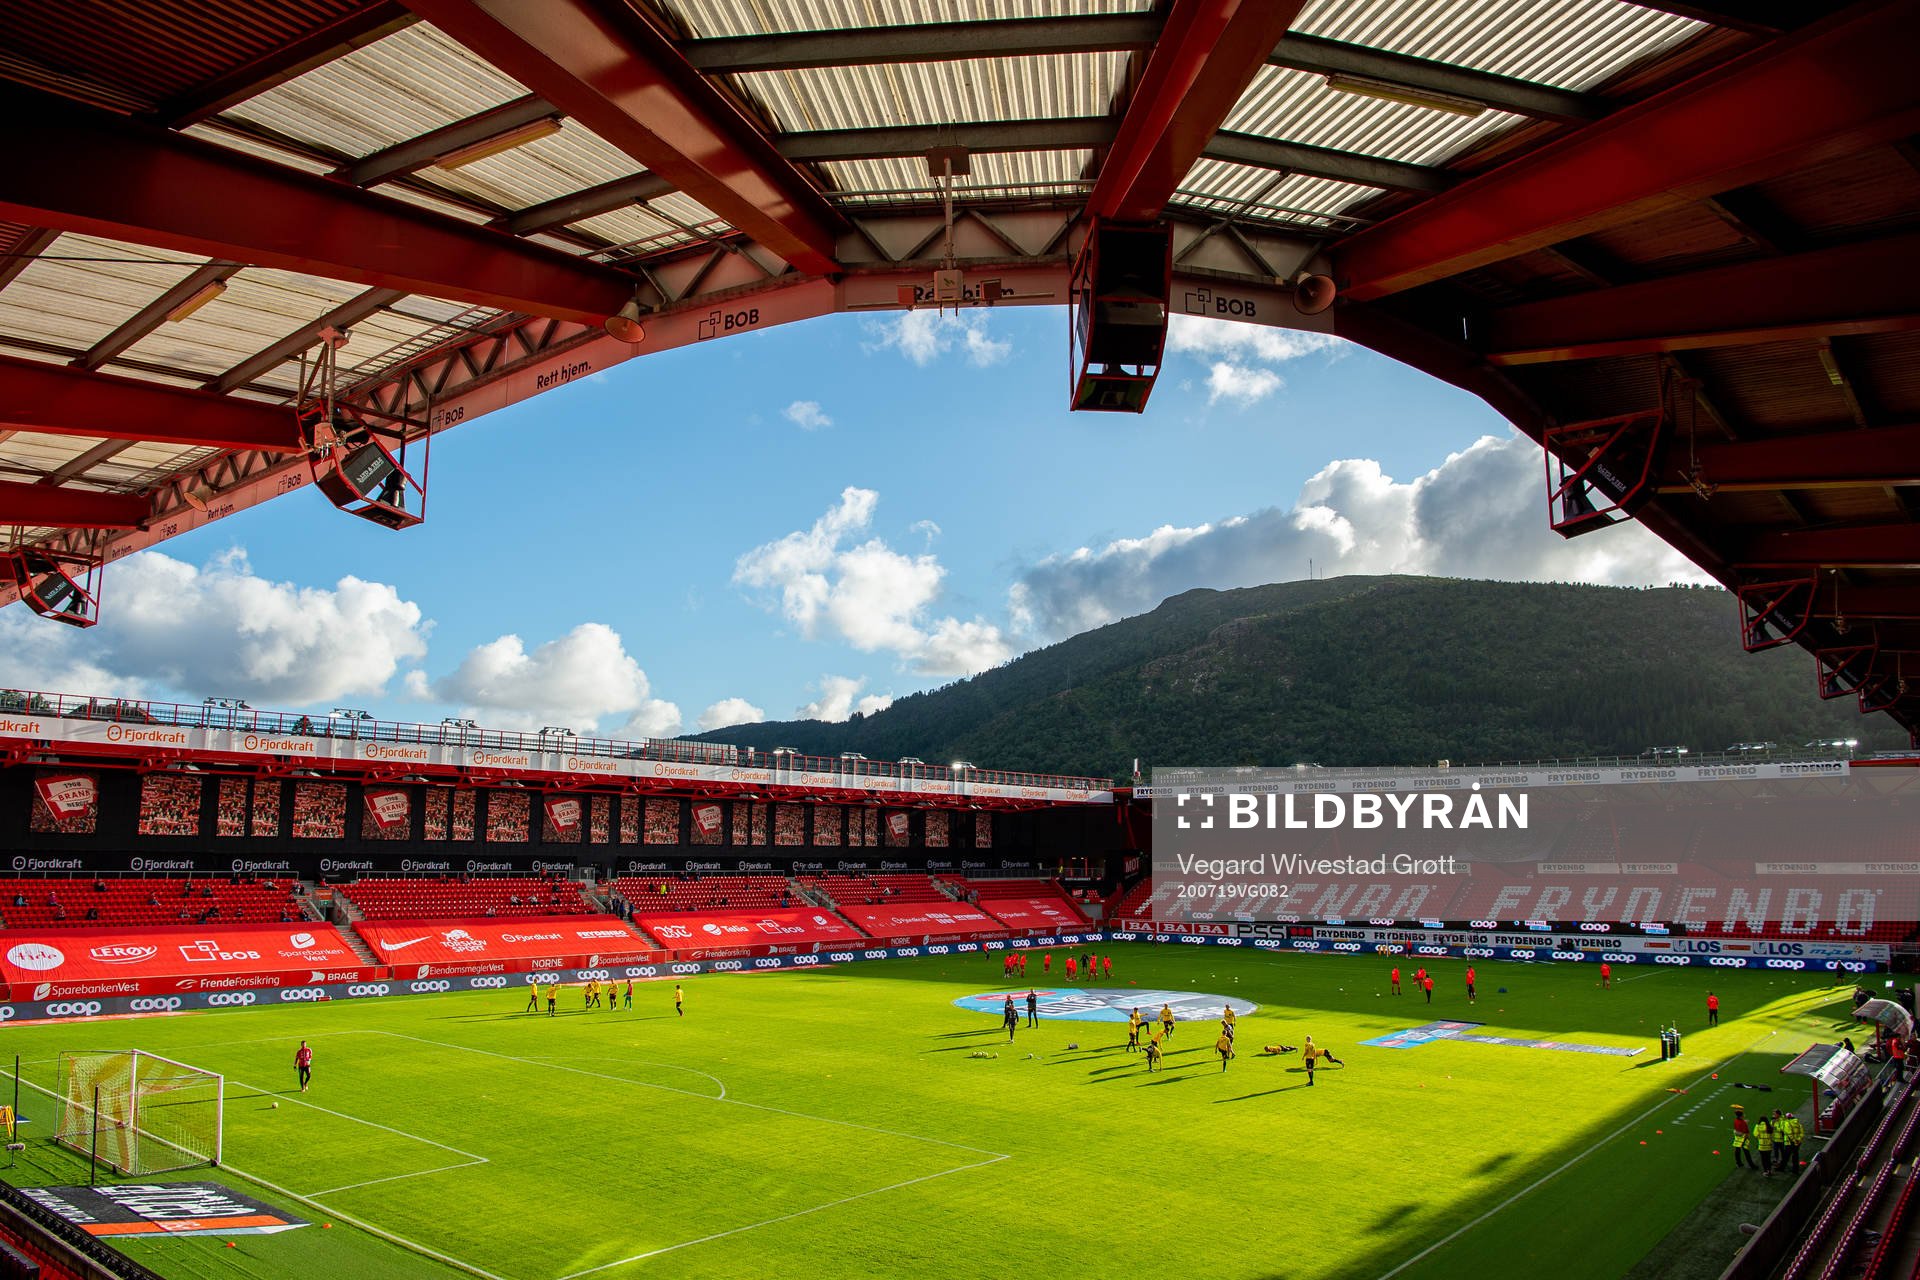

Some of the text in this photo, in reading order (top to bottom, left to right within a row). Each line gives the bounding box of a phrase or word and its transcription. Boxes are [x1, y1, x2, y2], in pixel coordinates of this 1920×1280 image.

[1216, 297, 1256, 317] BOB
[724, 309, 759, 330] BOB
[537, 360, 592, 389] Rett hjem.
[445, 407, 464, 425] BOB
[287, 474, 301, 488] BOB
[166, 523, 177, 535] BOB
[125, 729, 186, 743] Fjordkraft
[260, 739, 314, 751] Fjordkraft
[379, 747, 427, 758] Fjordkraft
[485, 754, 528, 766] Fjordkraft
[578, 760, 617, 771] Fjordkraft
[664, 766, 699, 776] Fjordkraft
[740, 772, 771, 781] Fjordkraft
[808, 776, 838, 785] Fjordkraft
[28, 858, 82, 870] Fjordkraft
[144, 858, 194, 870] Fjordkraft
[245, 860, 290, 871] Fjordkraft
[331, 860, 373, 871] Fjordkraft
[411, 861, 450, 871] Fjordkraft
[476, 861, 512, 871] Fjordkraft
[542, 862, 574, 871] Fjordkraft
[637, 862, 666, 871] Fjordkraft
[693, 862, 721, 871] Fjordkraft
[1192, 912, 1213, 920] coop
[1277, 913, 1300, 923] coop
[1369, 917, 1394, 926] coop
[1470, 920, 1497, 929] coop
[1580, 923, 1610, 933] coop
[515, 933, 563, 942] Fjordkraft
[1038, 937, 1055, 946] coop
[1062, 935, 1080, 944] coop
[1086, 933, 1103, 942] coop
[1181, 935, 1205, 944] coop
[1217, 937, 1241, 946] coop
[986, 941, 1005, 950] coop
[1012, 939, 1030, 948] coop
[1254, 939, 1280, 948] coop
[1293, 940, 1319, 950] coop
[1333, 943, 1361, 952] coop
[1687, 941, 1721, 953] LOS
[90, 945, 153, 958] LERØY
[278, 949, 344, 958] Sparebanken
[897, 947, 919, 956] coop
[929, 945, 949, 954] coop
[1464, 948, 1494, 958] coop
[1768, 942, 1804, 956] LOS
[219, 951, 261, 960] BOB
[830, 953, 854, 962] coop
[865, 950, 887, 959] coop
[1552, 951, 1585, 961] coop
[1602, 953, 1636, 963] coop
[1655, 954, 1691, 965] coop
[532, 959, 563, 968] NORNE
[756, 958, 781, 968] coop
[794, 955, 819, 965] coop
[1709, 956, 1747, 968] coop
[1765, 958, 1805, 970] coop
[672, 963, 701, 974] coop
[715, 960, 742, 971] coop
[327, 972, 358, 980] BRAGE
[577, 970, 609, 981] coop
[626, 967, 657, 977] coop
[471, 976, 507, 988] coop
[526, 972, 560, 983] coop
[348, 984, 390, 997] coop
[411, 980, 450, 992] coop
[208, 992, 256, 1005] coop
[281, 988, 325, 1001] coop
[46, 1001, 102, 1016] coop
[130, 997, 182, 1011] coop
